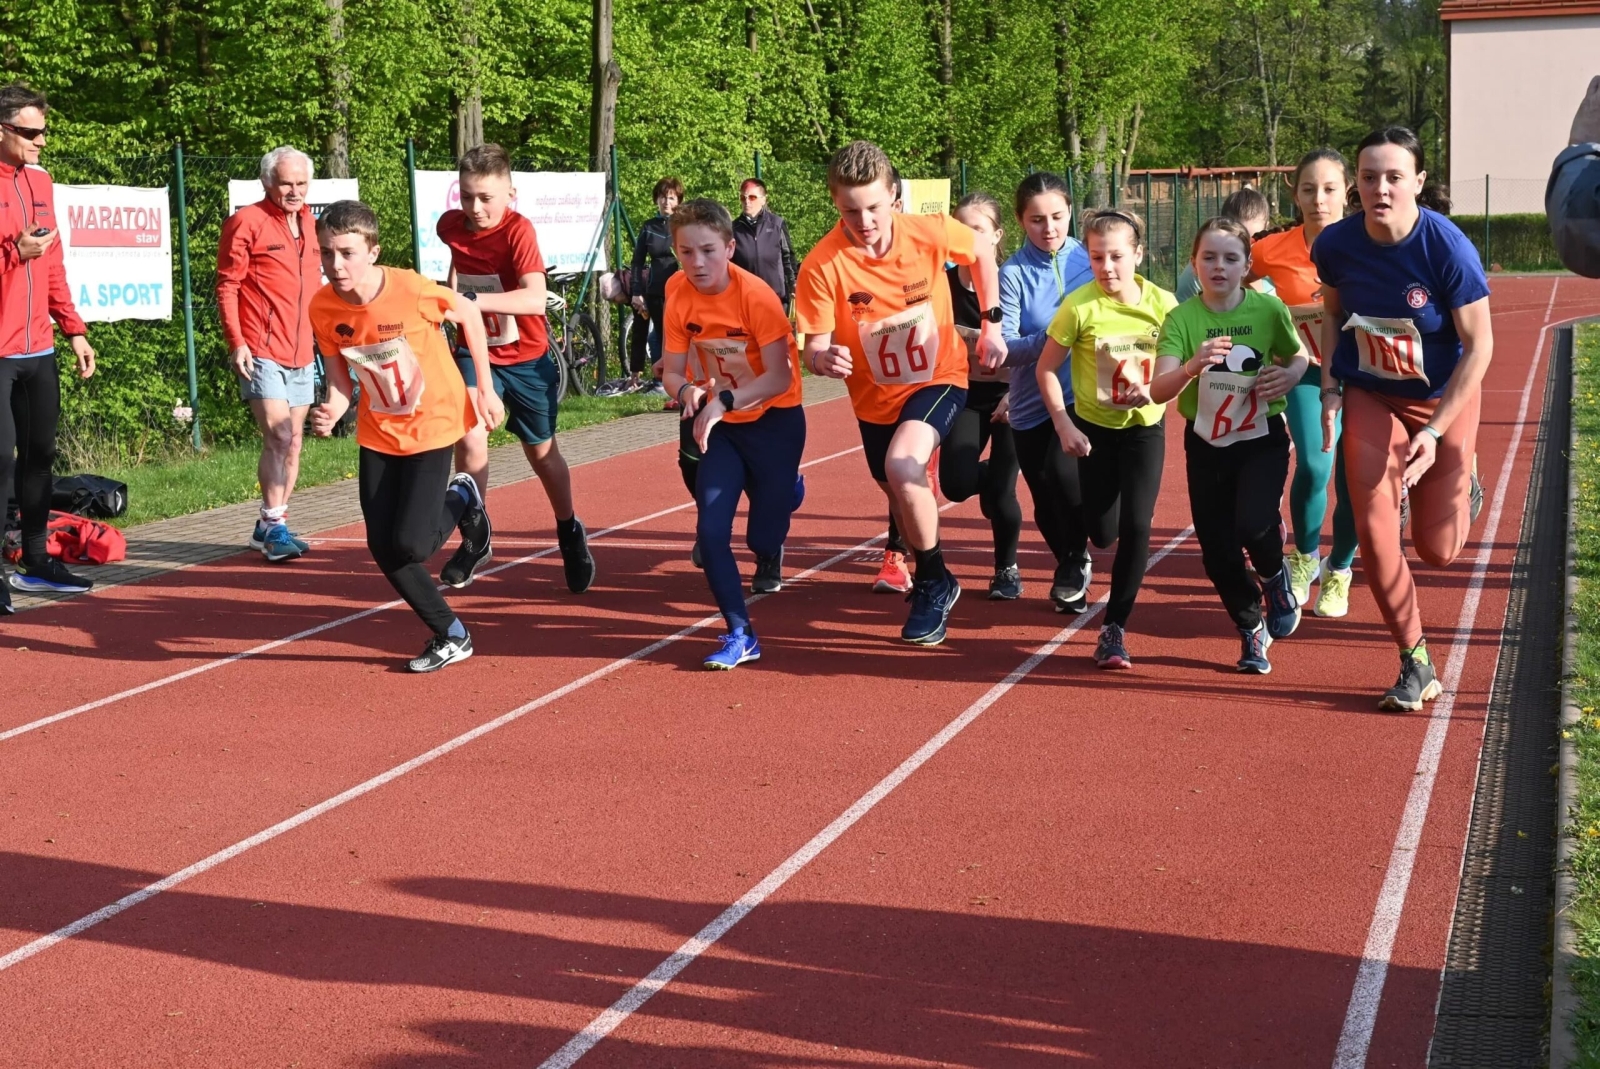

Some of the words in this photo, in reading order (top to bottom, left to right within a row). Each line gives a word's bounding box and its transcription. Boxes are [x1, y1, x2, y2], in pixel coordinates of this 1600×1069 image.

[68, 205, 161, 230] MARATON
[136, 232, 159, 244] stav
[79, 284, 92, 306] A
[97, 283, 163, 306] SPORT
[871, 325, 897, 338] PIVOVAR
[897, 313, 924, 331] TRUTNOV
[1294, 313, 1317, 321] PIVOVAR
[1206, 328, 1223, 338] JSEM
[1226, 325, 1252, 337] LENOCH
[1375, 326, 1406, 335] TRUTNOV
[373, 348, 400, 361] TRUTNOV
[716, 346, 738, 356] TRUTNOV
[878, 325, 928, 378] 66
[1105, 344, 1130, 353] PIVOVAR
[714, 355, 738, 389] 5
[363, 360, 407, 408] 17
[1112, 358, 1150, 405] 61
[1210, 381, 1235, 392] PIVOVAR
[1211, 389, 1257, 441] 62
